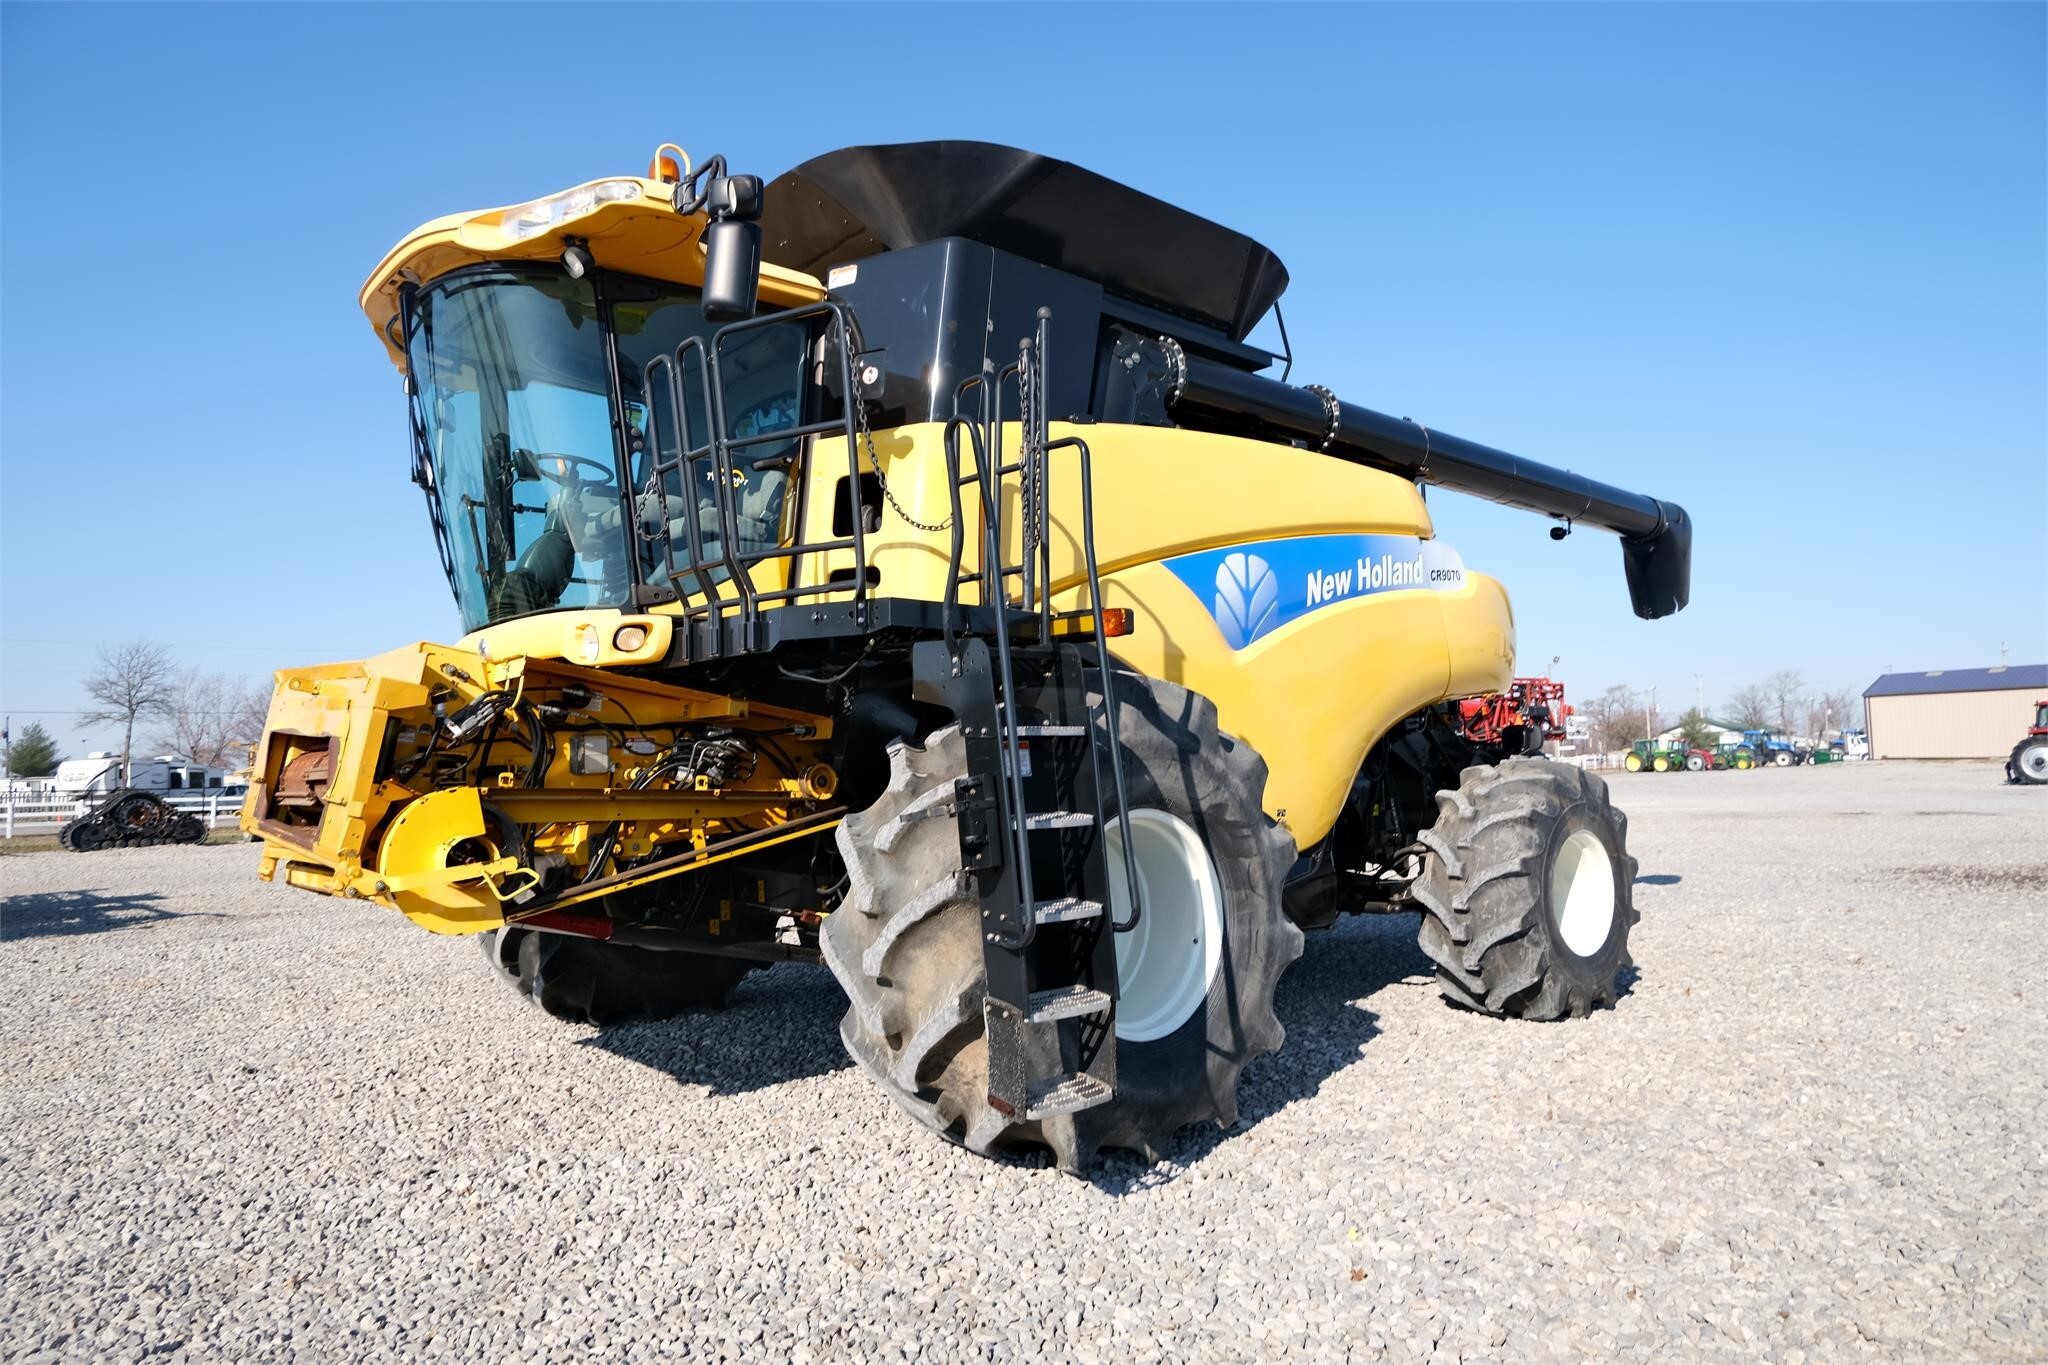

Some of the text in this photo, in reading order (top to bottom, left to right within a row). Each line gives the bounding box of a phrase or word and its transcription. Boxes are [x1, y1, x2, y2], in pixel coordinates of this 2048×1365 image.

[1306, 554, 1424, 607] New Holland
[1430, 569, 1461, 581] CR9070
